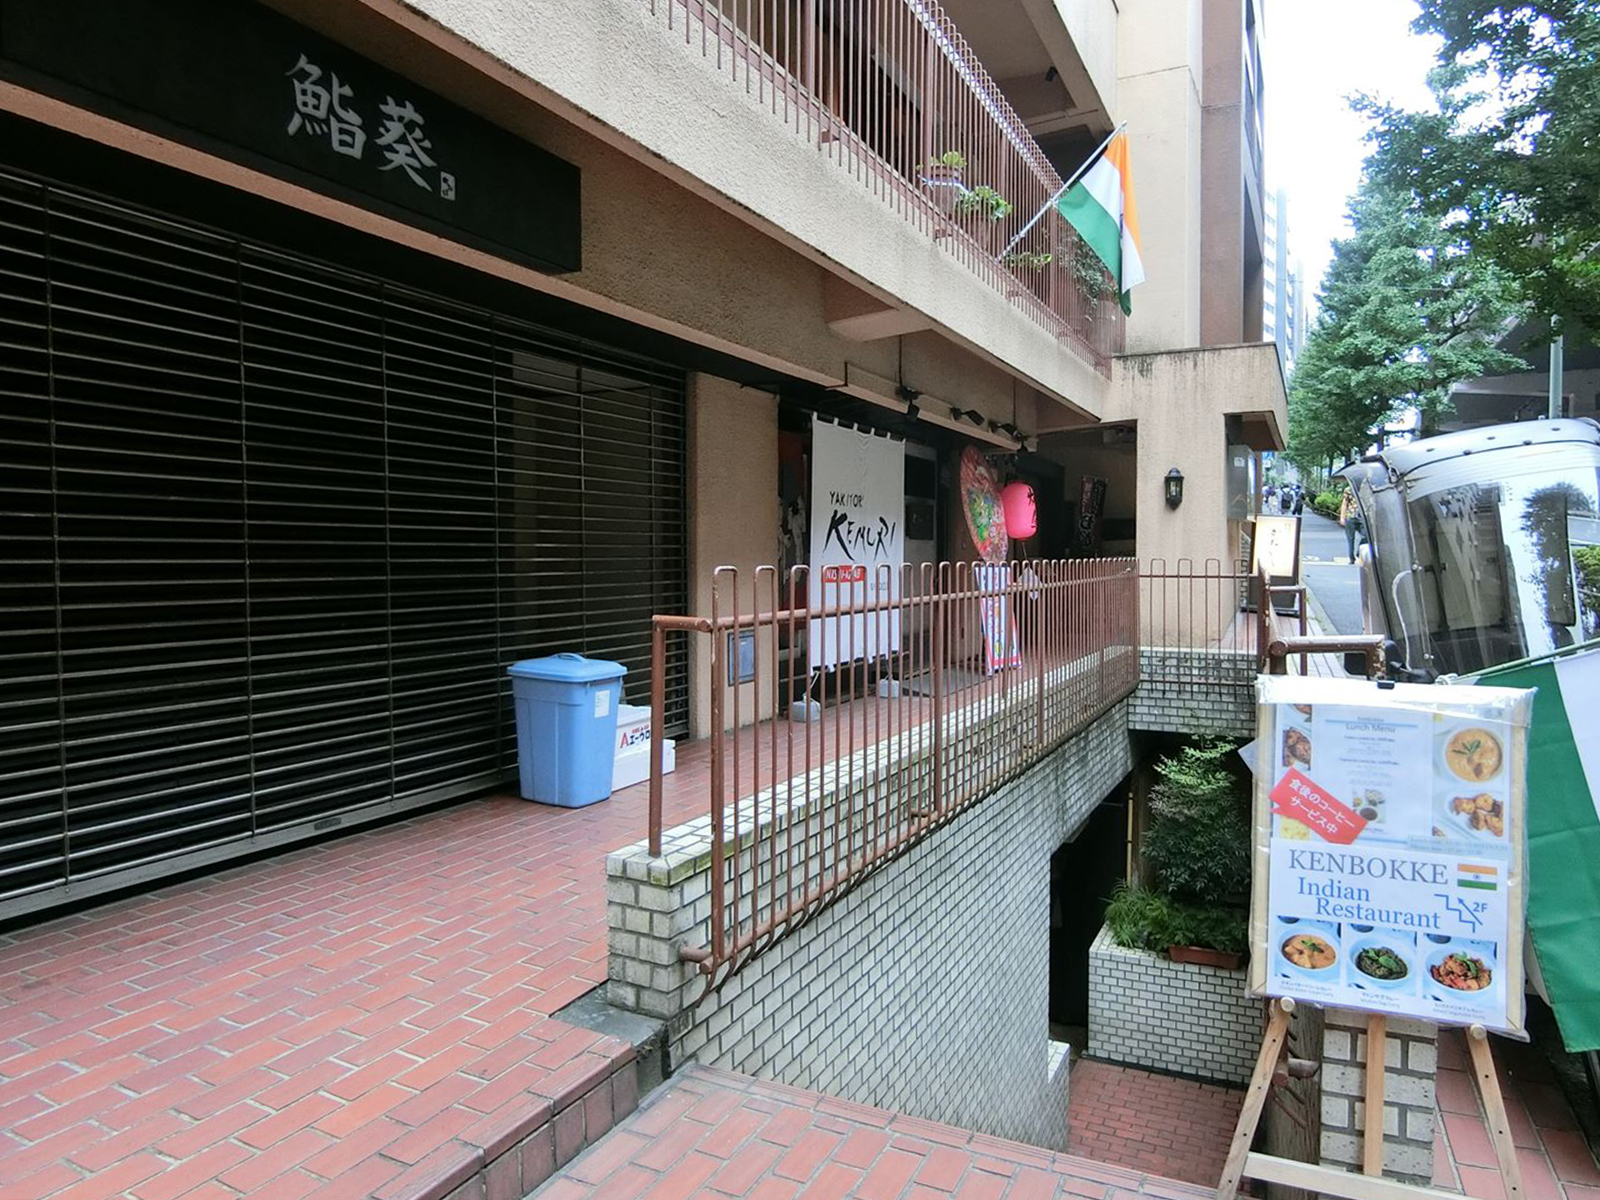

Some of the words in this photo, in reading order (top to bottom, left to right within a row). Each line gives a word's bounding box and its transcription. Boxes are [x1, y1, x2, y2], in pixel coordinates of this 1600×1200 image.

[285, 53, 437, 192] 鮨葵
[1289, 778, 1355, 828] 食後のコーヒー
[1290, 796, 1338, 834] サービス中
[1288, 849, 1449, 885] KENBOKKE
[1298, 876, 1370, 902] Indian
[1316, 898, 1442, 930] Restaurant
[1472, 902, 1488, 913] 2F
